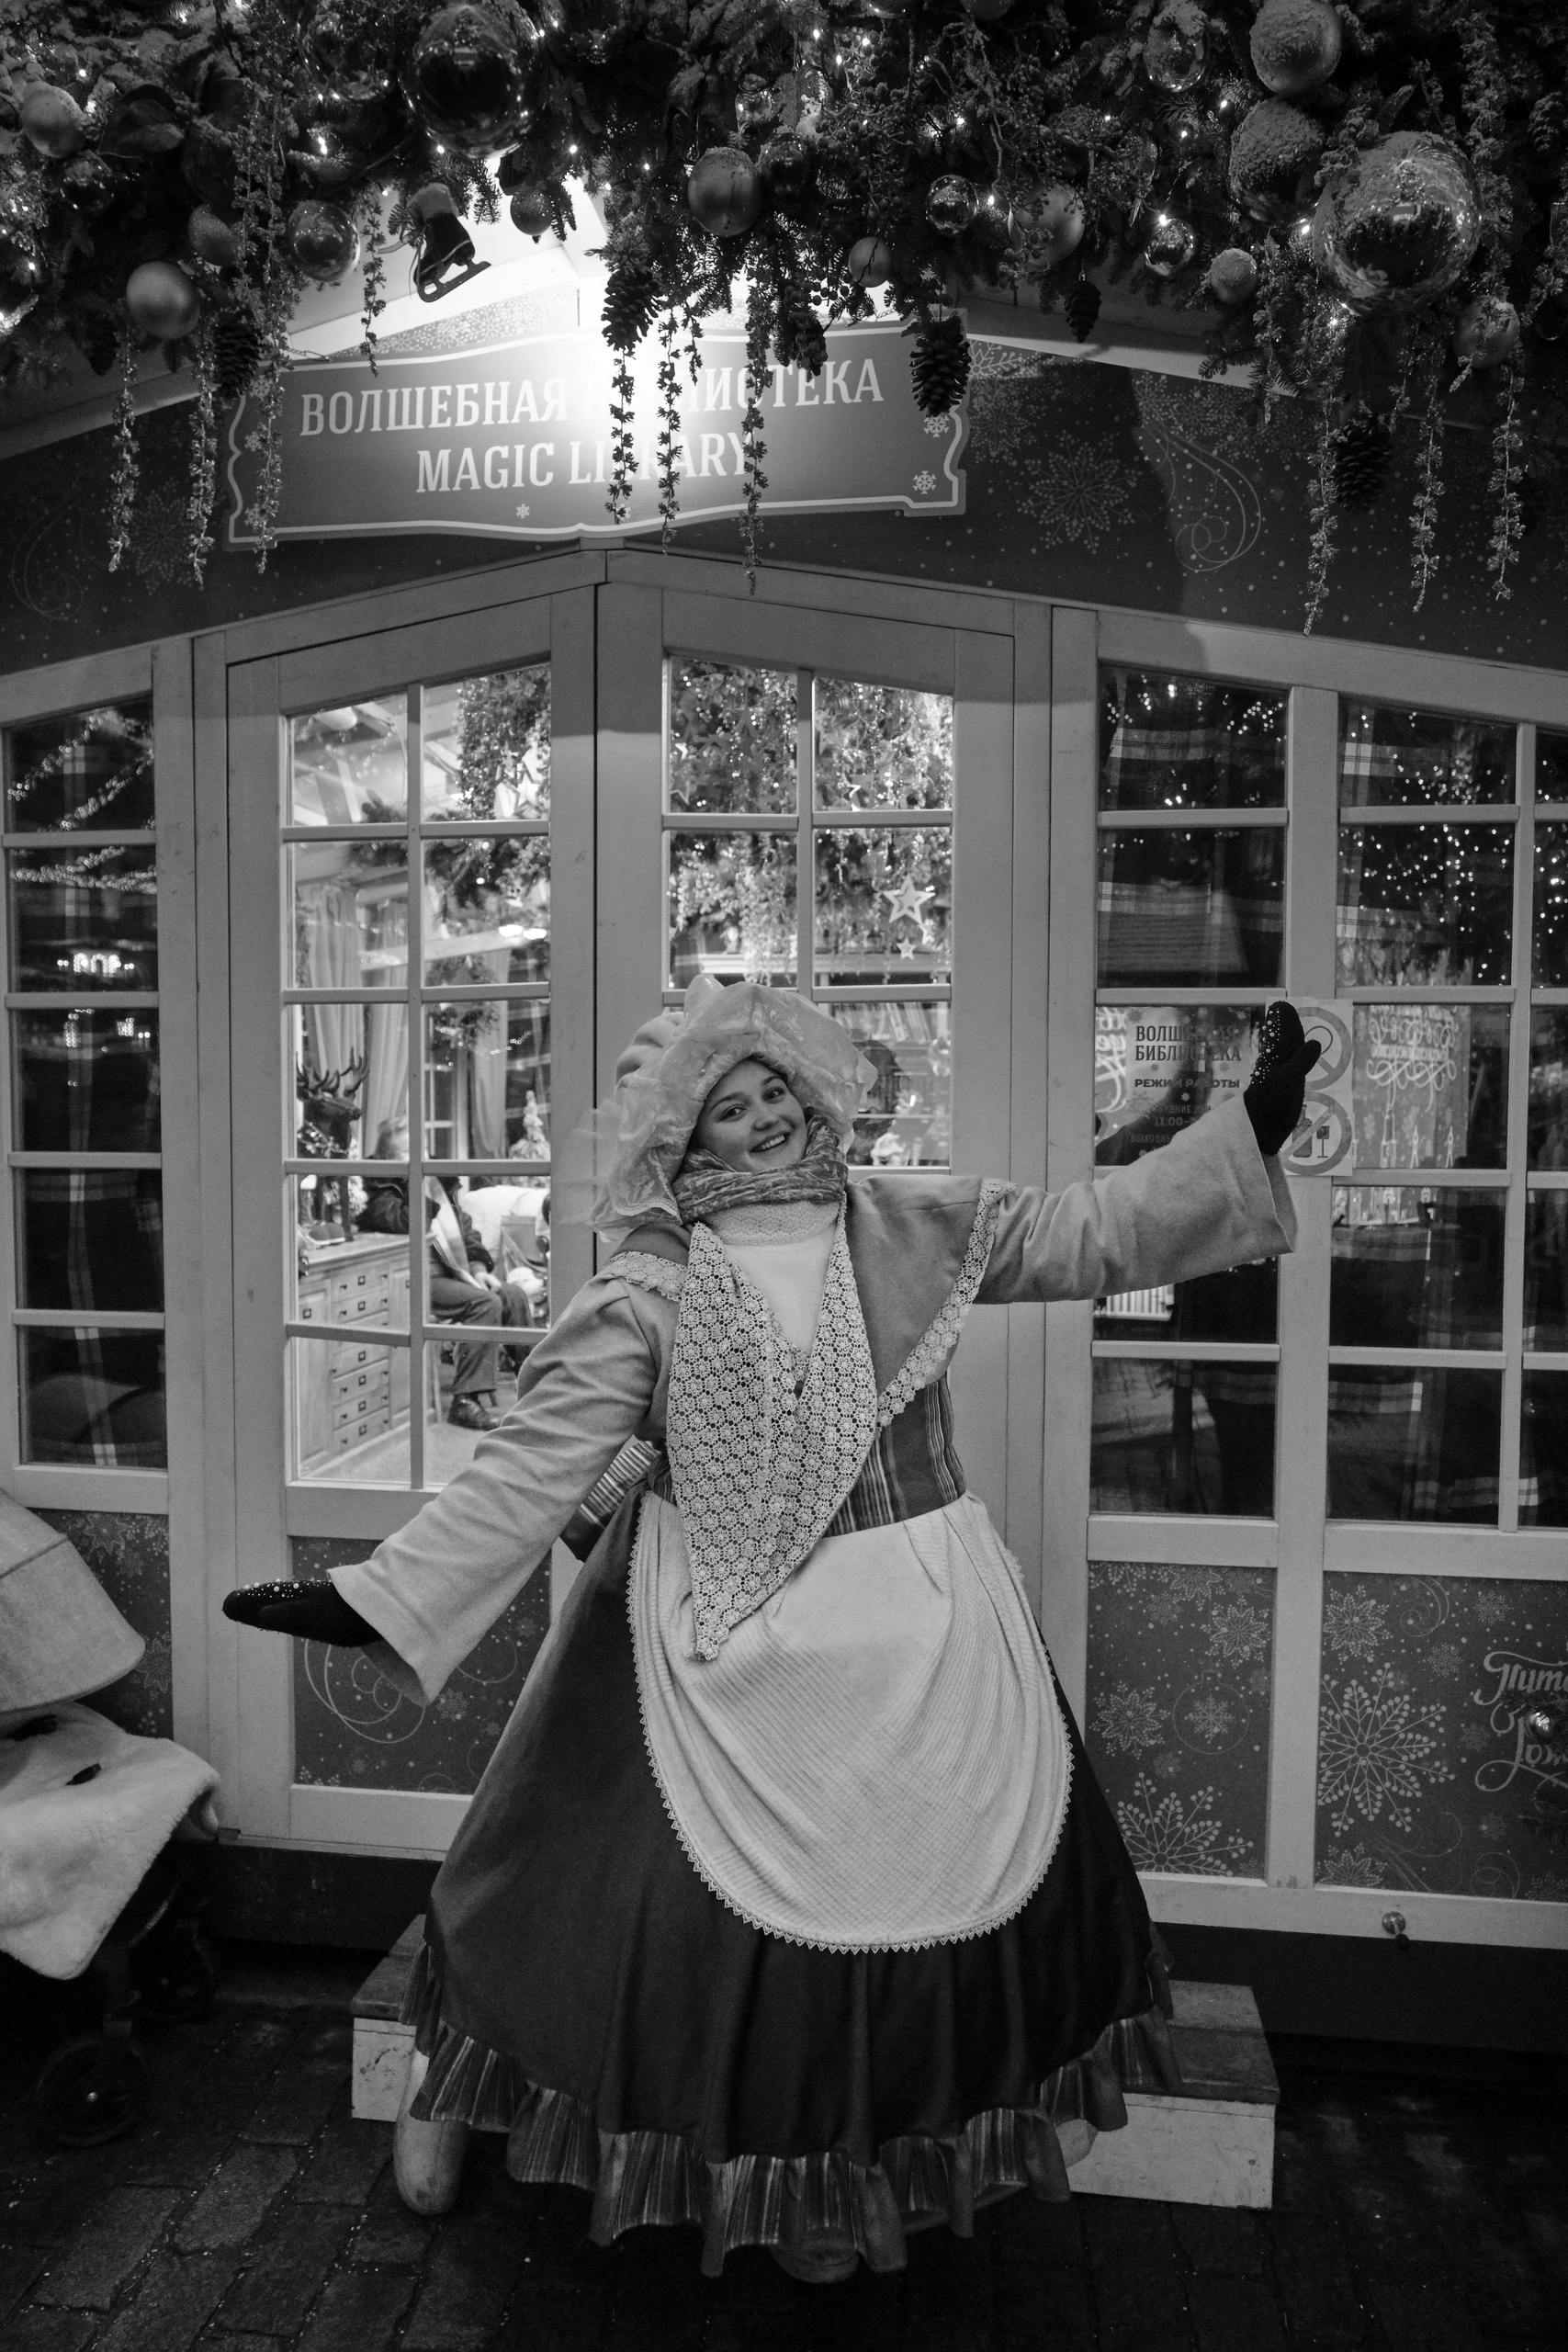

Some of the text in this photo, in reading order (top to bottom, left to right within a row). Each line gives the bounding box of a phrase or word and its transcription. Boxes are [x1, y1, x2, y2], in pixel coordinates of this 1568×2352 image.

[299, 358, 884, 436] ВОЛШЕБНАЯ БЛИОТЕКА
[416, 442, 555, 493] MAGIC
[1135, 1025, 1237, 1042] ВОЛШЕАЯ
[1135, 1045, 1241, 1061] БИБЛИОЕКА
[1159, 1104, 1192, 1114] УДНИЕ
